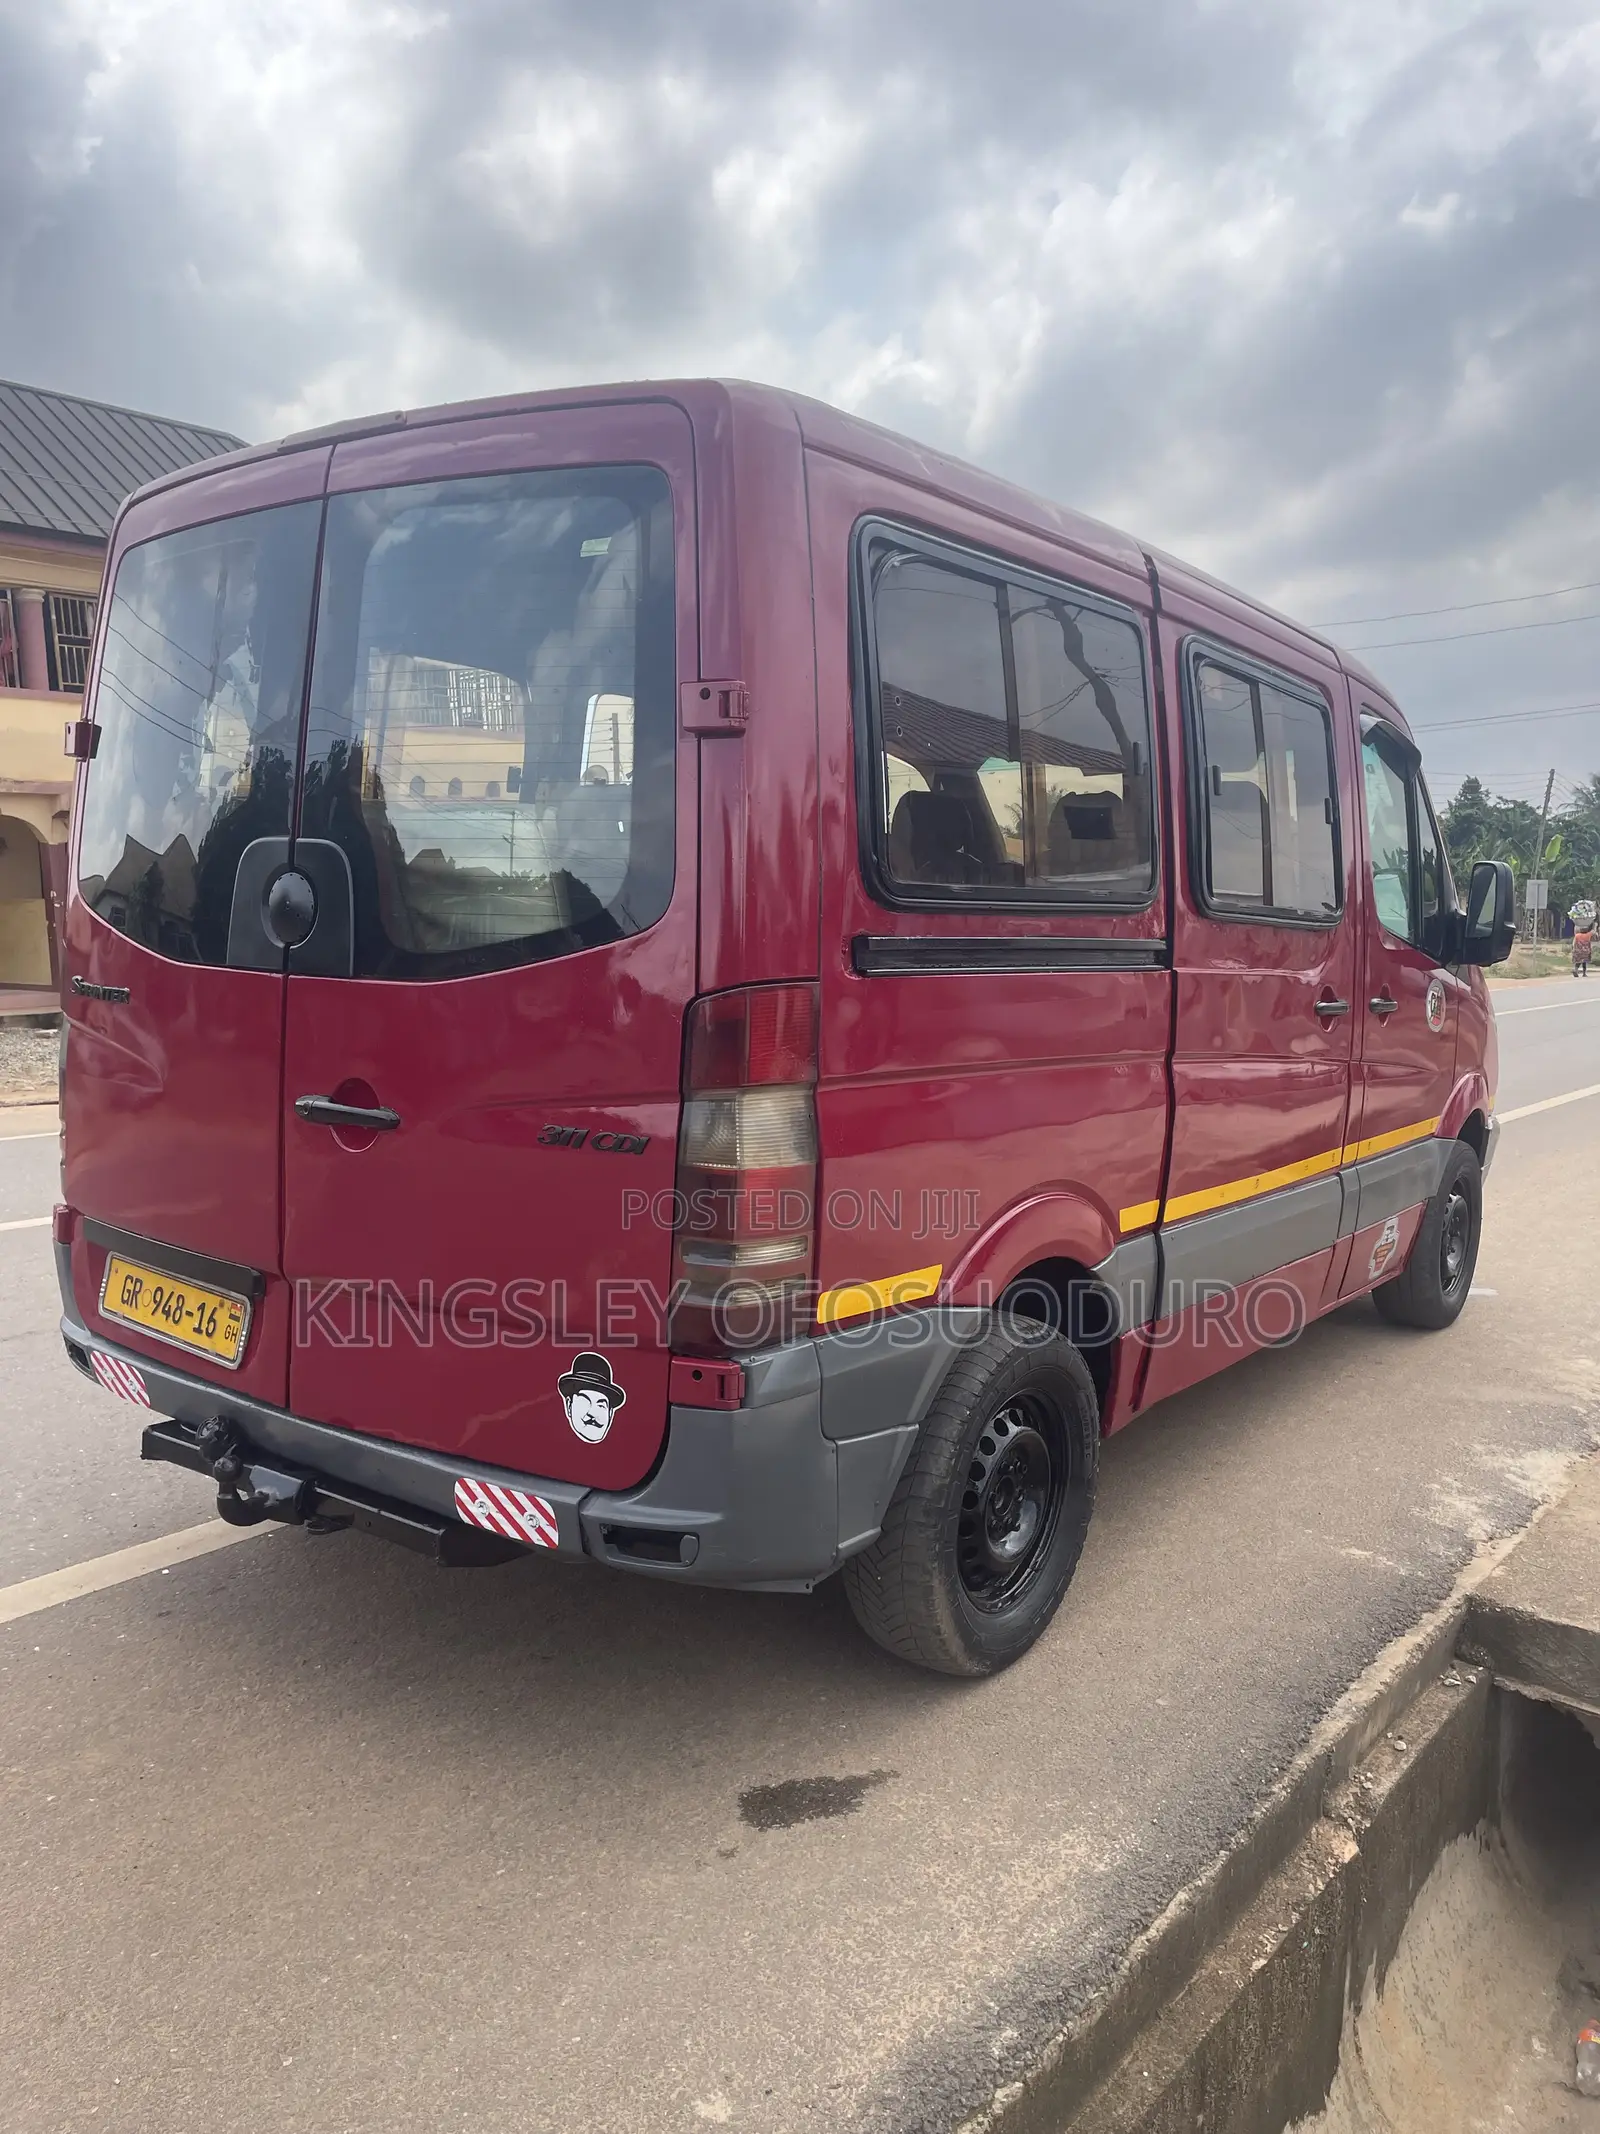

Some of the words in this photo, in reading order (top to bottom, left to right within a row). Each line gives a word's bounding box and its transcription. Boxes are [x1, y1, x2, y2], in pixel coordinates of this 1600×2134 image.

[537, 1124, 591, 1149] 311
[591, 1131, 652, 1155] CDI
[121, 1274, 143, 1310] GR
[151, 1287, 218, 1337] 948-16
[224, 1324, 239, 1344] GH
